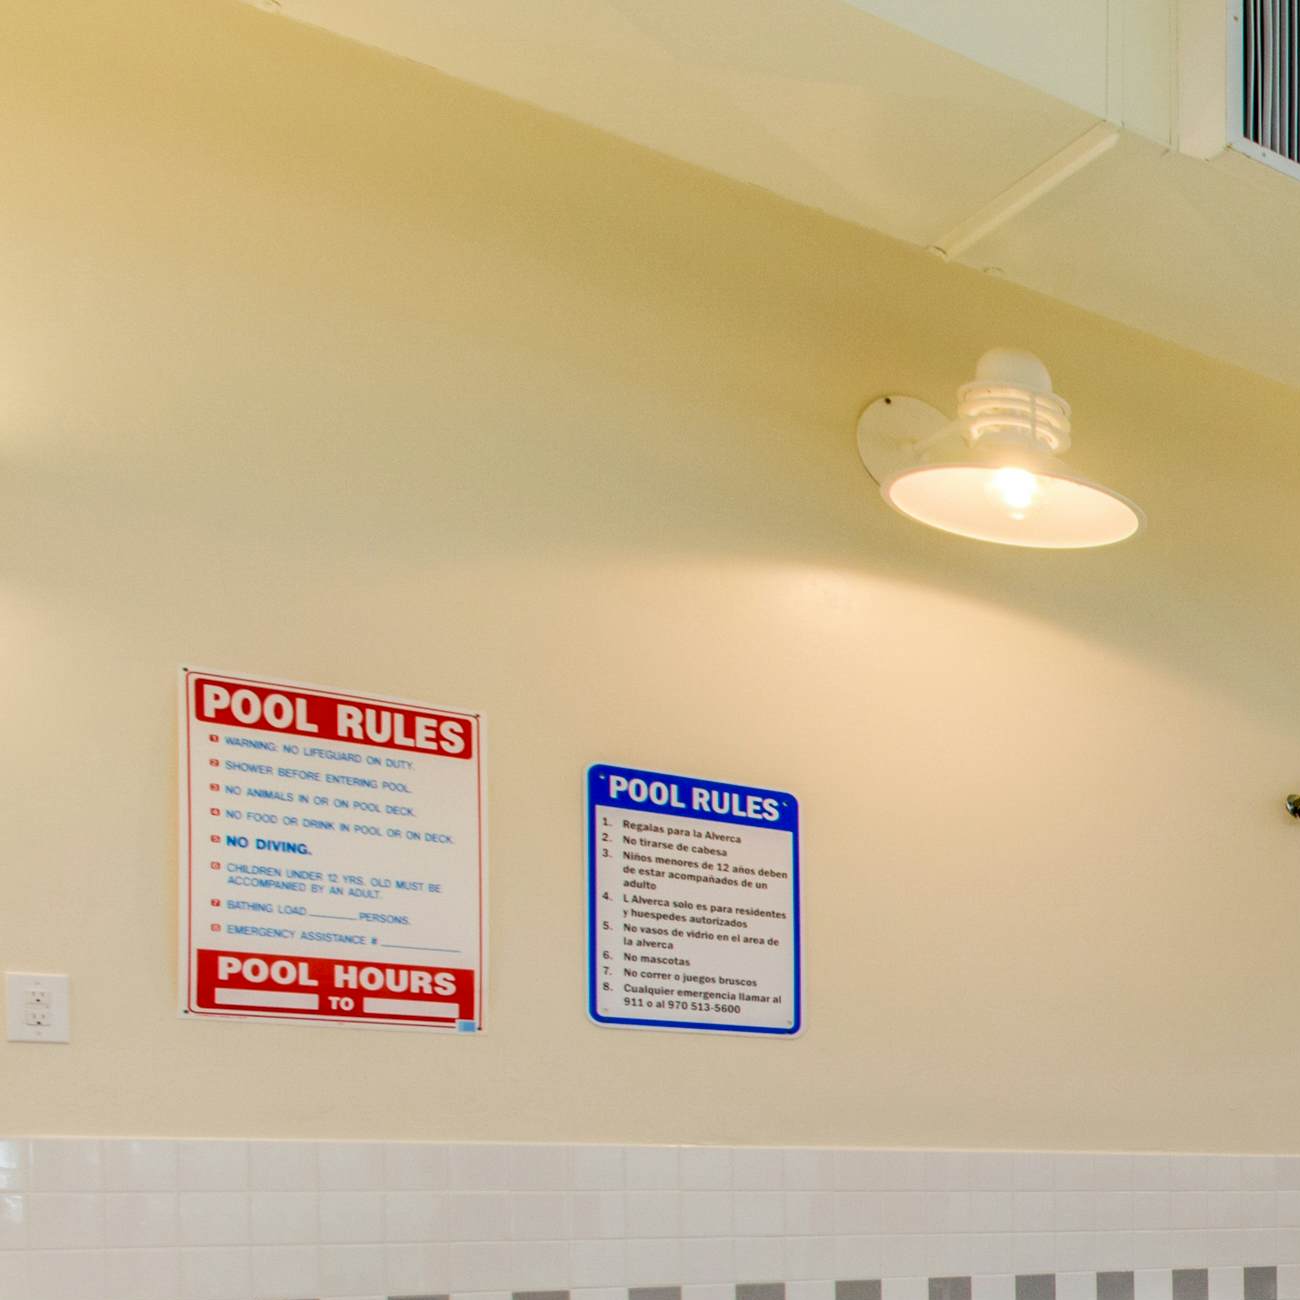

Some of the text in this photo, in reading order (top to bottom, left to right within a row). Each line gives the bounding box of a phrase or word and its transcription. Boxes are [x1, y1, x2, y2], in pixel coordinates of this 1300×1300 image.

[202, 683, 466, 754] POOL RULES
[224, 737, 278, 752] WARNING:
[283, 745, 299, 754] NO
[304, 748, 362, 764] LIFEGUARD
[367, 756, 381, 765] ON
[225, 760, 274, 775] SHOWER
[278, 768, 320, 782] BEFORE
[326, 774, 377, 789] ENTERING
[225, 785, 241, 796] NO
[246, 789, 294, 802] ANIMALS
[298, 795, 309, 803] IN
[314, 796, 329, 806] OR
[334, 799, 349, 808] ON
[353, 801, 381, 813] POOL
[609, 775, 780, 821] POOL RULES
[226, 810, 242, 820] NO
[247, 812, 278, 824] FOOD
[283, 816, 298, 826] OR
[303, 818, 335, 831] DRINK
[340, 823, 350, 832] IN
[354, 824, 382, 836] POOL
[387, 829, 402, 838] OR
[406, 831, 421, 840] ON
[667, 827, 690, 838] para
[693, 829, 702, 838] la
[705, 831, 741, 844] Alverca
[226, 835, 249, 849] NO
[255, 839, 312, 855] DIVING.
[623, 835, 637, 846] No
[640, 838, 673, 851] tirarse
[677, 843, 689, 852] de
[691, 845, 728, 857] cabesa
[227, 863, 281, 877] CHILDREN
[286, 870, 322, 882] UNDER
[371, 878, 391, 888] OLD
[395, 880, 425, 892] MUST
[428, 884, 441, 893] BE
[623, 865, 636, 875] de
[639, 867, 665, 878] estar
[741, 878, 753, 887] de
[755, 881, 768, 889] un
[655, 857, 699, 869] menores
[701, 862, 714, 871] de
[717, 863, 730, 872] 12
[758, 869, 788, 879] deben
[227, 876, 306, 892] ACCOMPANIED
[311, 883, 326, 894] BY
[329, 886, 344, 895] AN
[623, 879, 657, 890] adulto
[227, 900, 274, 913] BATHING
[278, 904, 307, 915] LOAD
[632, 895, 670, 908] Alverca
[673, 901, 694, 910] solo
[710, 904, 733, 914] para
[735, 907, 787, 919] residentes
[623, 909, 748, 929] y huespedes autorizados
[227, 925, 296, 940] EMERGENCY
[300, 931, 366, 945] ASSISTANCE
[623, 923, 638, 933] No
[640, 926, 669, 937] vasos
[672, 929, 684, 937] de
[687, 930, 714, 941] vidrio
[717, 934, 729, 942] en
[731, 934, 740, 943] el
[743, 936, 765, 945] area
[768, 937, 779, 946] de
[623, 937, 674, 950] la alverca
[623, 953, 638, 962] No
[640, 956, 690, 967] mascotas
[217, 955, 457, 996] POOL HOURS
[623, 968, 638, 978] No
[640, 971, 671, 981] correr
[683, 974, 716, 985] juegos
[719, 976, 758, 987] bruscos
[328, 996, 355, 1011] TO
[623, 984, 674, 996] Cualquier
[677, 990, 736, 1001] emergencia
[738, 993, 770, 1003] llamar
[773, 996, 781, 1004] al
[624, 997, 644, 1007] 911
[656, 999, 665, 1009] al
[668, 1000, 688, 1010] 970
[691, 1002, 741, 1014] 513-5600
